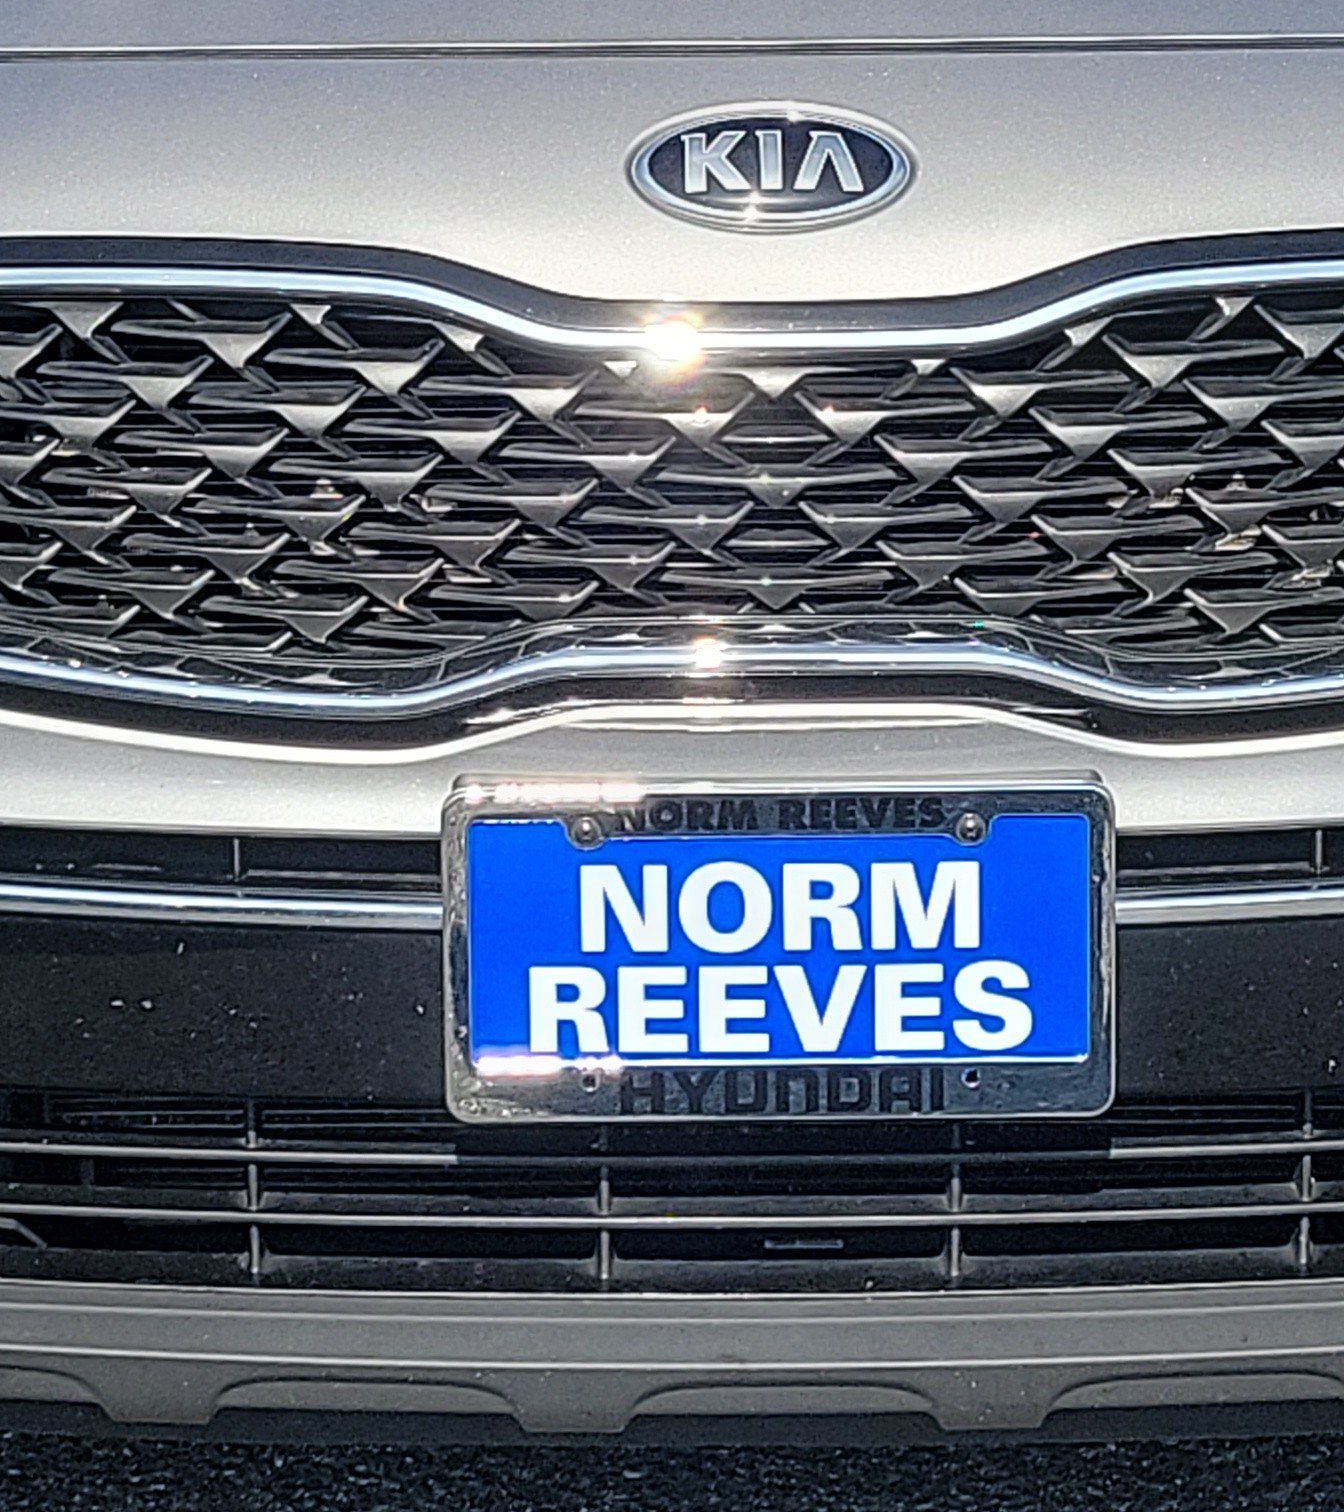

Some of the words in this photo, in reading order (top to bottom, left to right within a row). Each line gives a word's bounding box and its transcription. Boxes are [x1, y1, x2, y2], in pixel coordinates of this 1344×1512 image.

[681, 130, 864, 193] KIA
[619, 800, 759, 832] NORM
[777, 797, 948, 830] REEVES
[579, 860, 981, 954] NORM
[528, 959, 1034, 1054] REEVES
[619, 1067, 945, 1115] HYUNDAI
